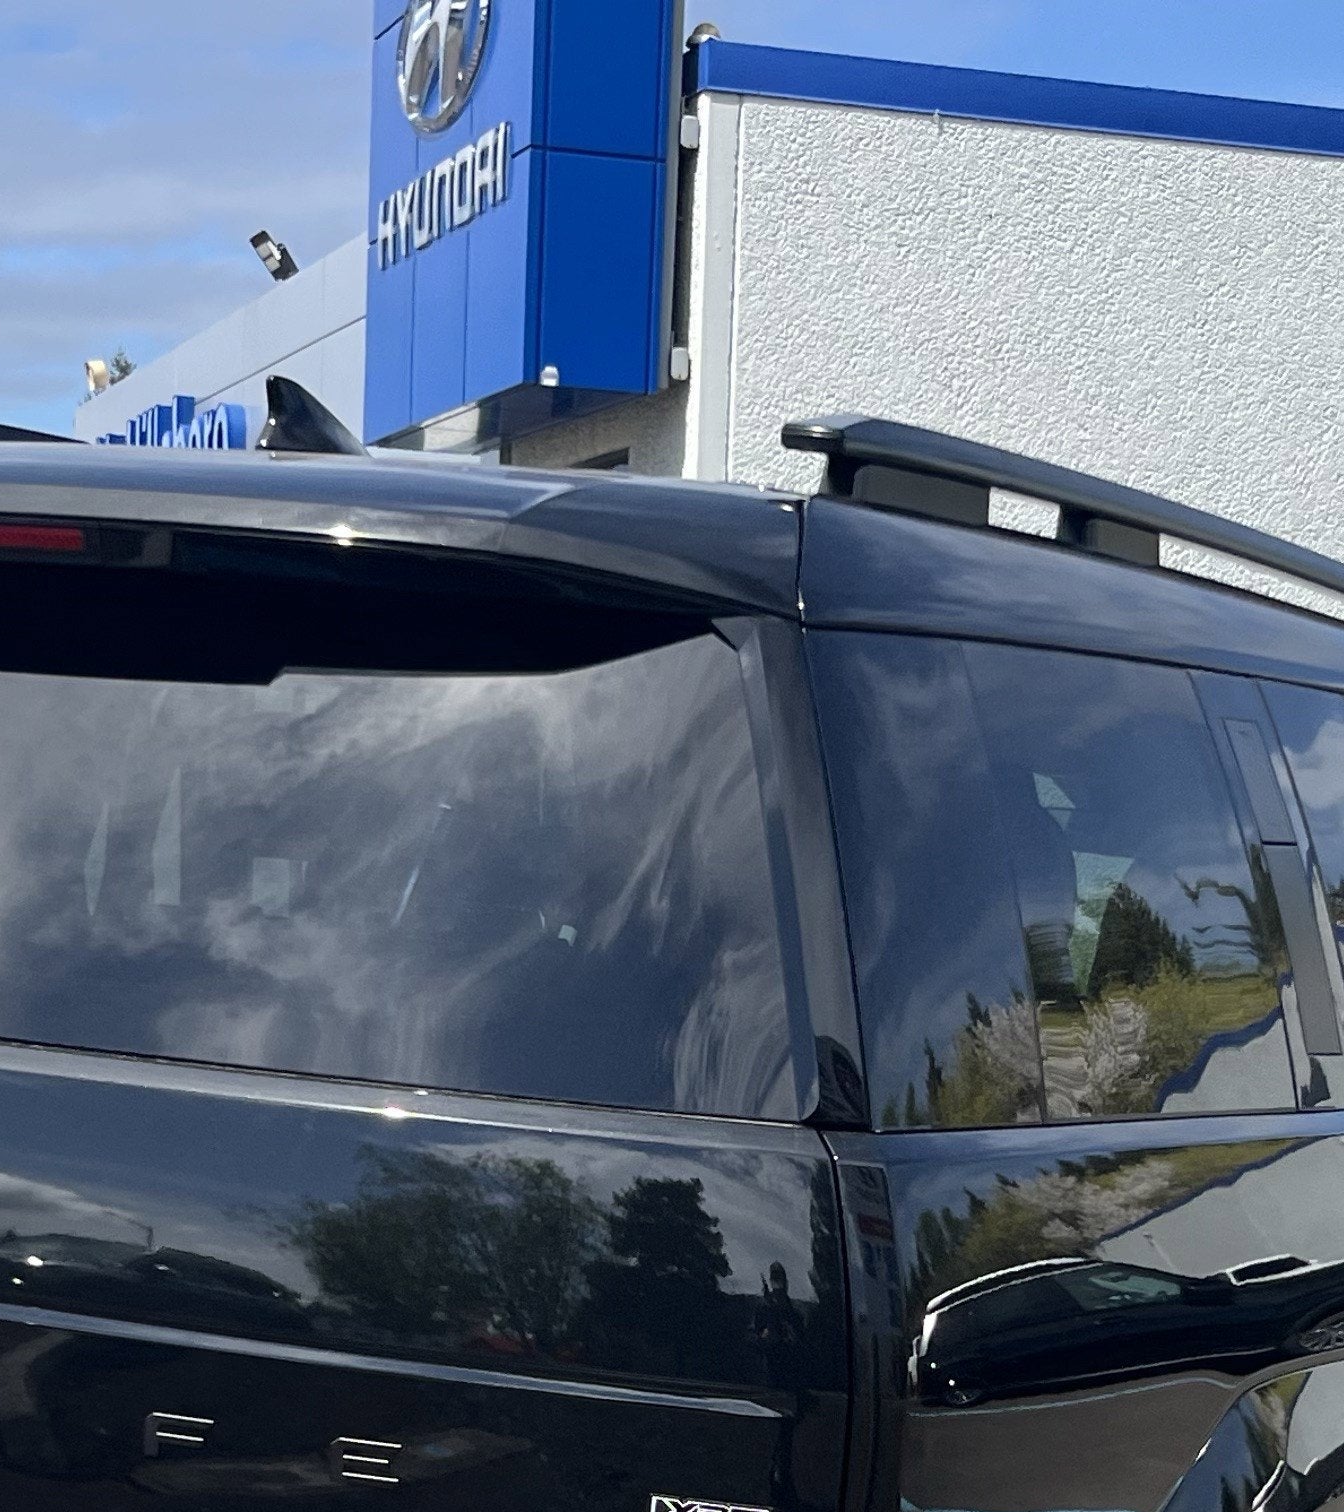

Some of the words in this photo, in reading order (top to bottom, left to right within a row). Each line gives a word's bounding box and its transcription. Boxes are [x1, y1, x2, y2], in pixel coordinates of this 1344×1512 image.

[377, 121, 513, 272] HYUNDAI
[126, 396, 234, 450] llboro
[143, 1411, 402, 1487] FE
